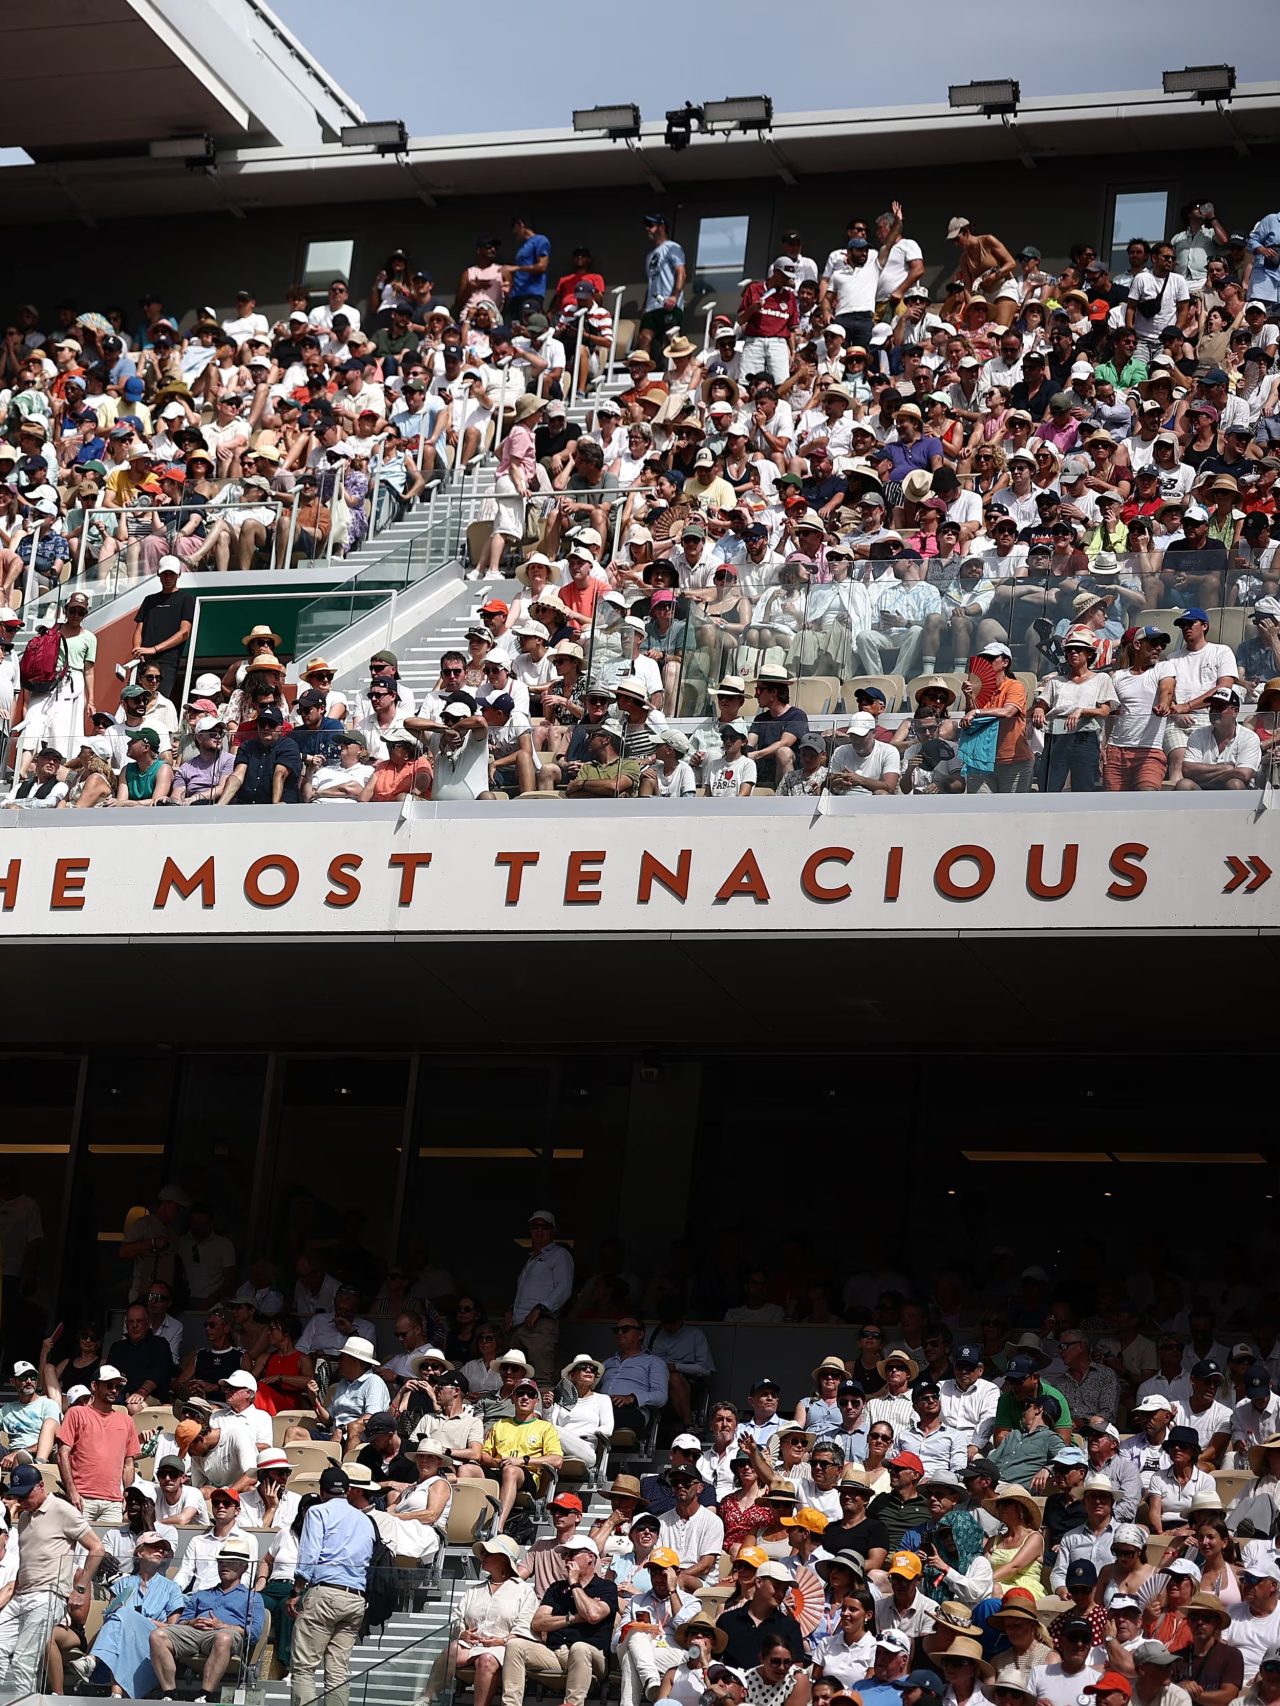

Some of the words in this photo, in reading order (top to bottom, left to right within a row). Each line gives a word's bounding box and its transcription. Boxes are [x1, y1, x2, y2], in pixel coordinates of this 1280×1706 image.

[712, 779, 736, 790] PARIS
[154, 853, 432, 907] MOST
[496, 844, 1148, 904] TENACIOUS
